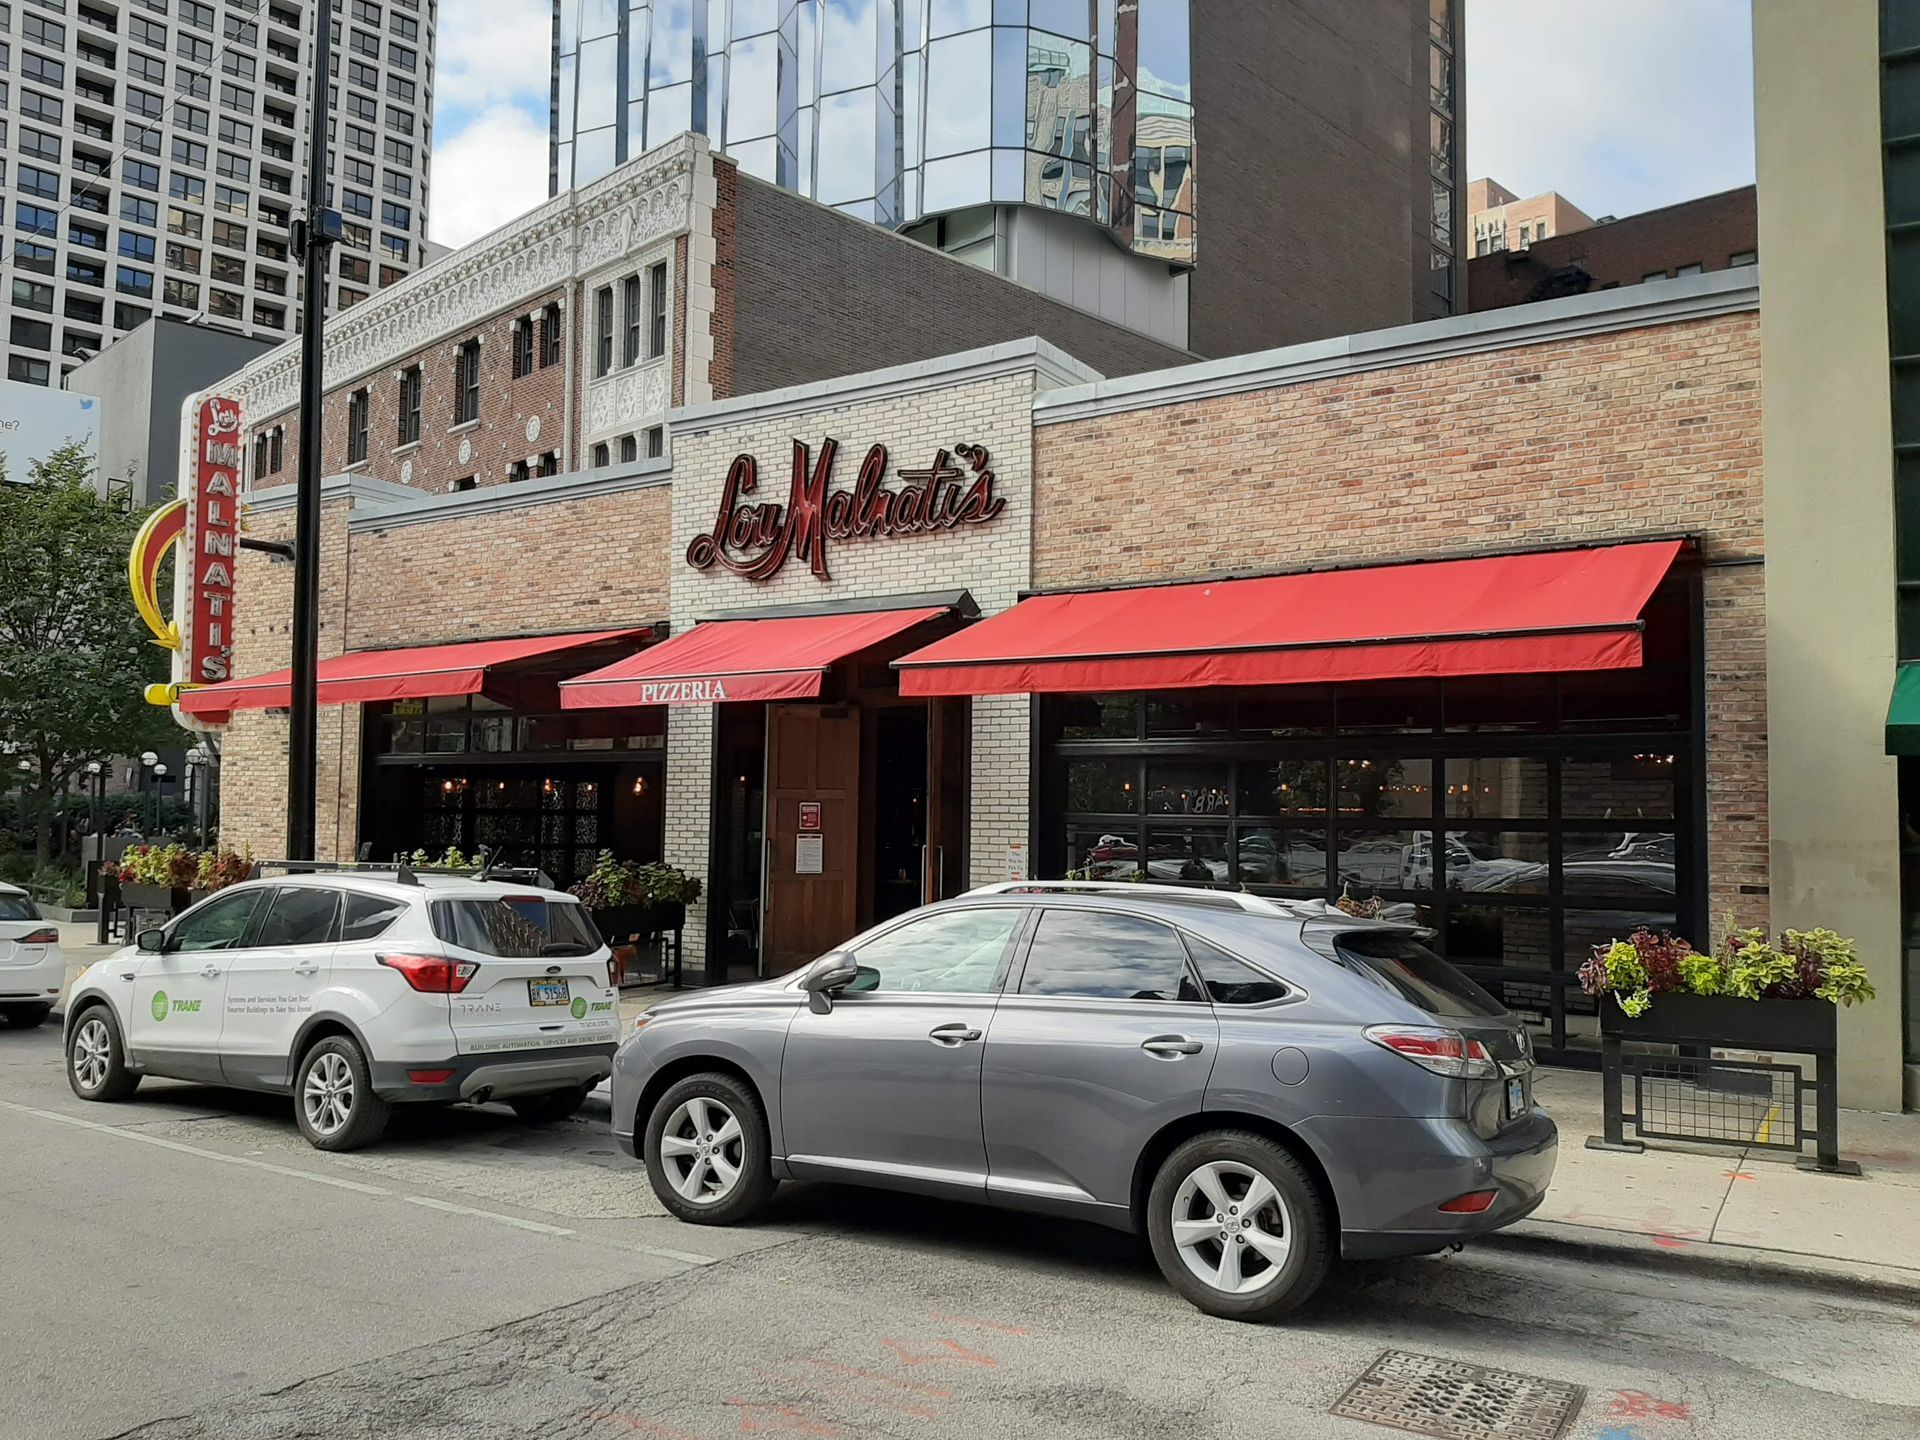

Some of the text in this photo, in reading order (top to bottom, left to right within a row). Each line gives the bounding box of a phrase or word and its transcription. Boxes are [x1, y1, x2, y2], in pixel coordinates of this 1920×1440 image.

[686, 437, 1006, 581] Lou Malnati's
[641, 680, 727, 702] PIZZERIA
[172, 1000, 202, 1012] TRANE
[460, 1002, 501, 1012] TRANE
[590, 1002, 613, 1011] TRANE
[470, 1043, 501, 1052] BUILDING
